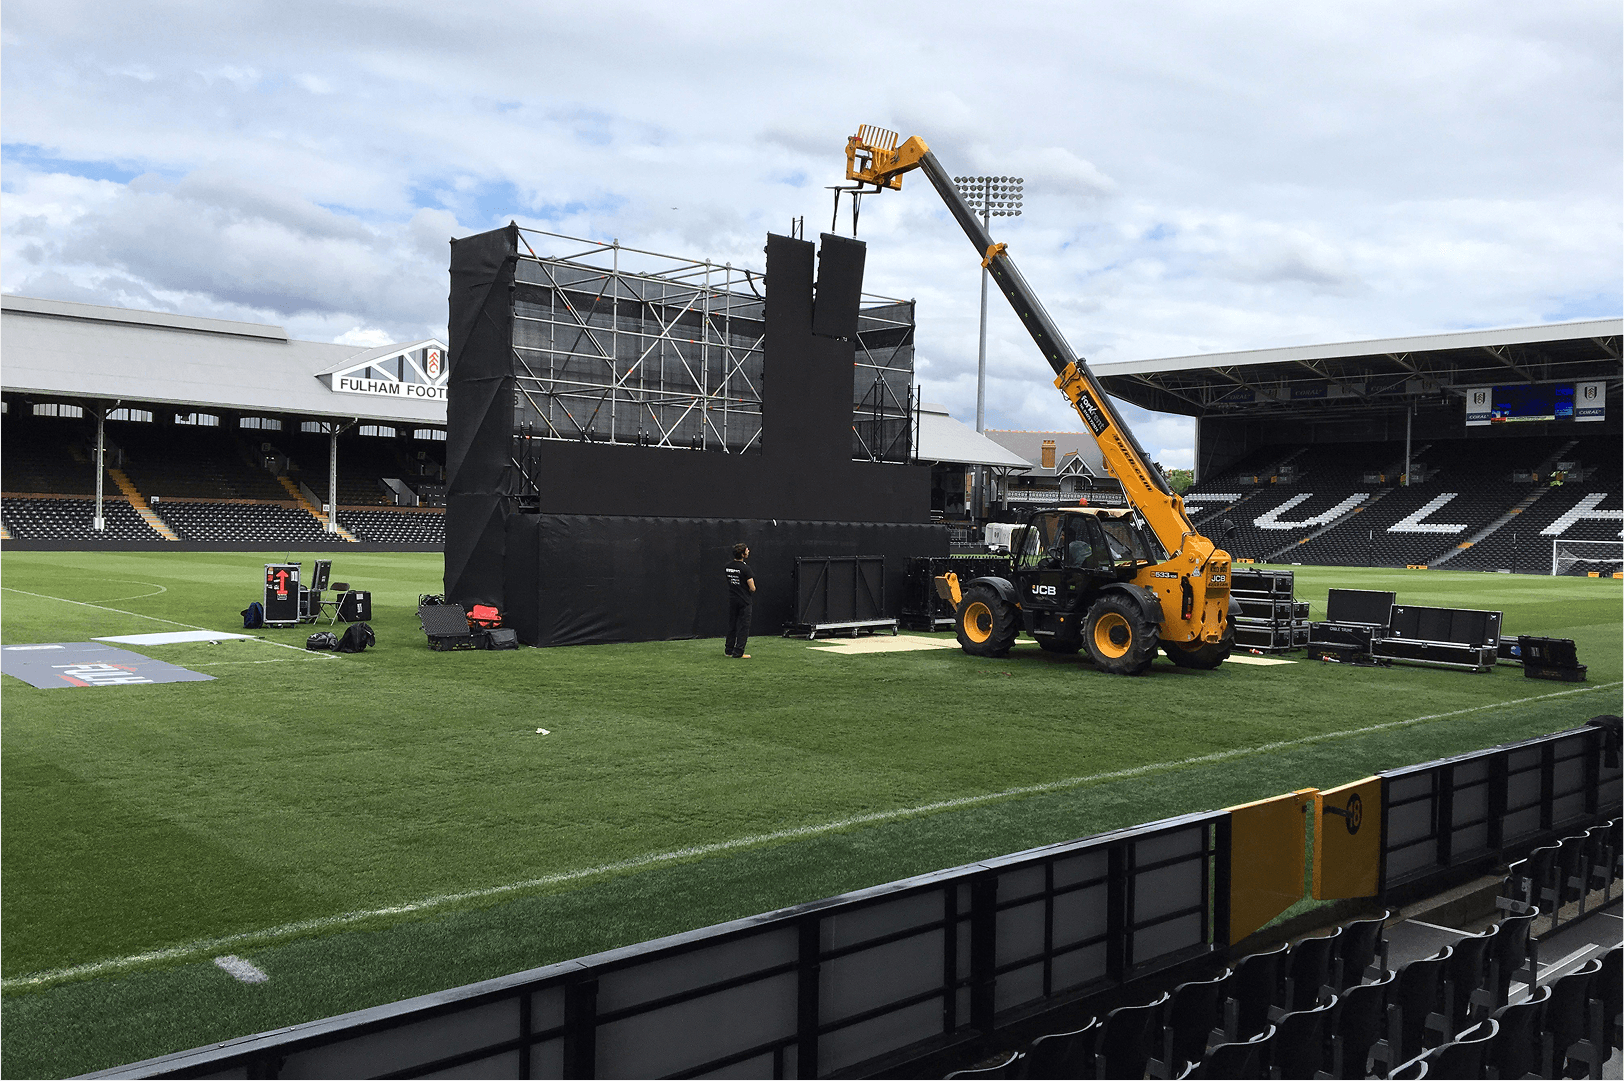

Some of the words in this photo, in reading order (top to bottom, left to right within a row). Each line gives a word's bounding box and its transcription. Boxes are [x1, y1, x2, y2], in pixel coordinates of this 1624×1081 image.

[340, 378, 400, 395] FULHAM
[407, 384, 448, 399] FOOT
[1032, 585, 1056, 596] JCB
[1347, 799, 1361, 828] 18
